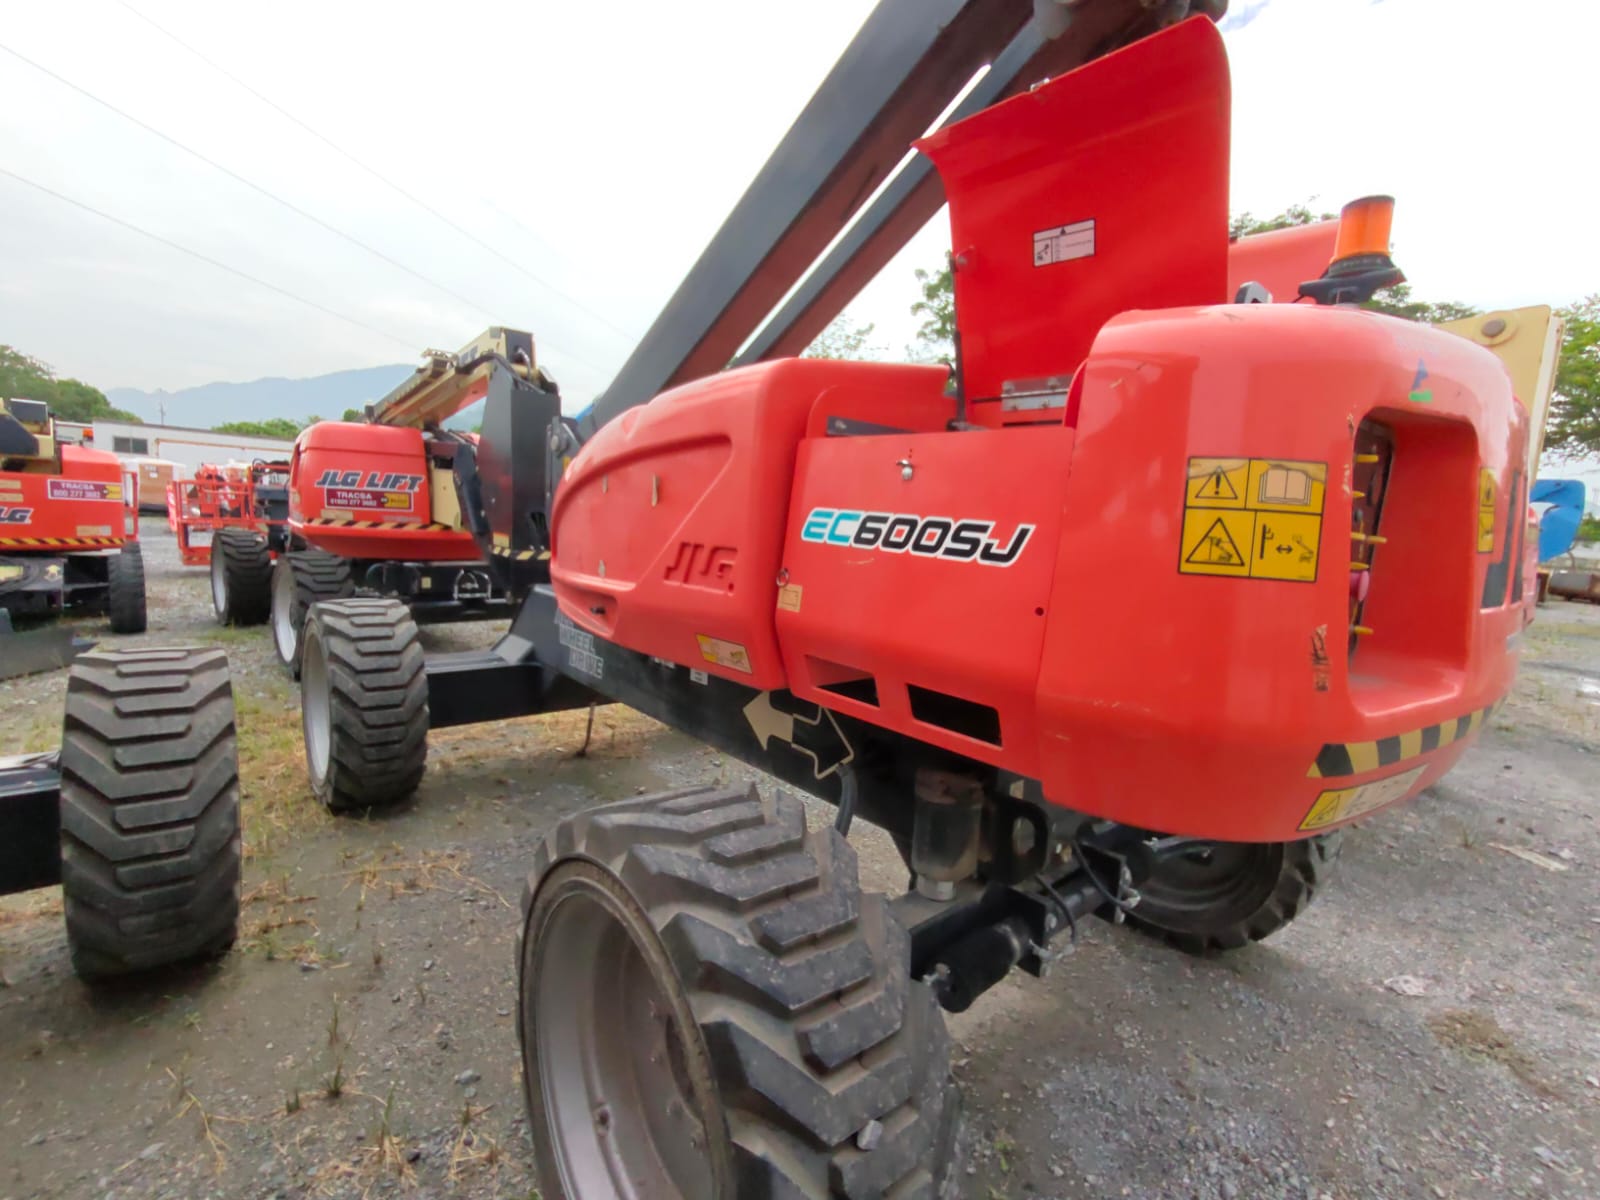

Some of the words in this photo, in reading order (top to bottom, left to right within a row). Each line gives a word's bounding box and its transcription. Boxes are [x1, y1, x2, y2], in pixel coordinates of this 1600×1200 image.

[314, 469, 362, 488] JLG
[364, 471, 424, 492] LIFT
[336, 491, 373, 500] TRACSA
[0, 505, 34, 525] LG
[801, 507, 1036, 567] EC600SJ
[663, 541, 738, 595] JLG
